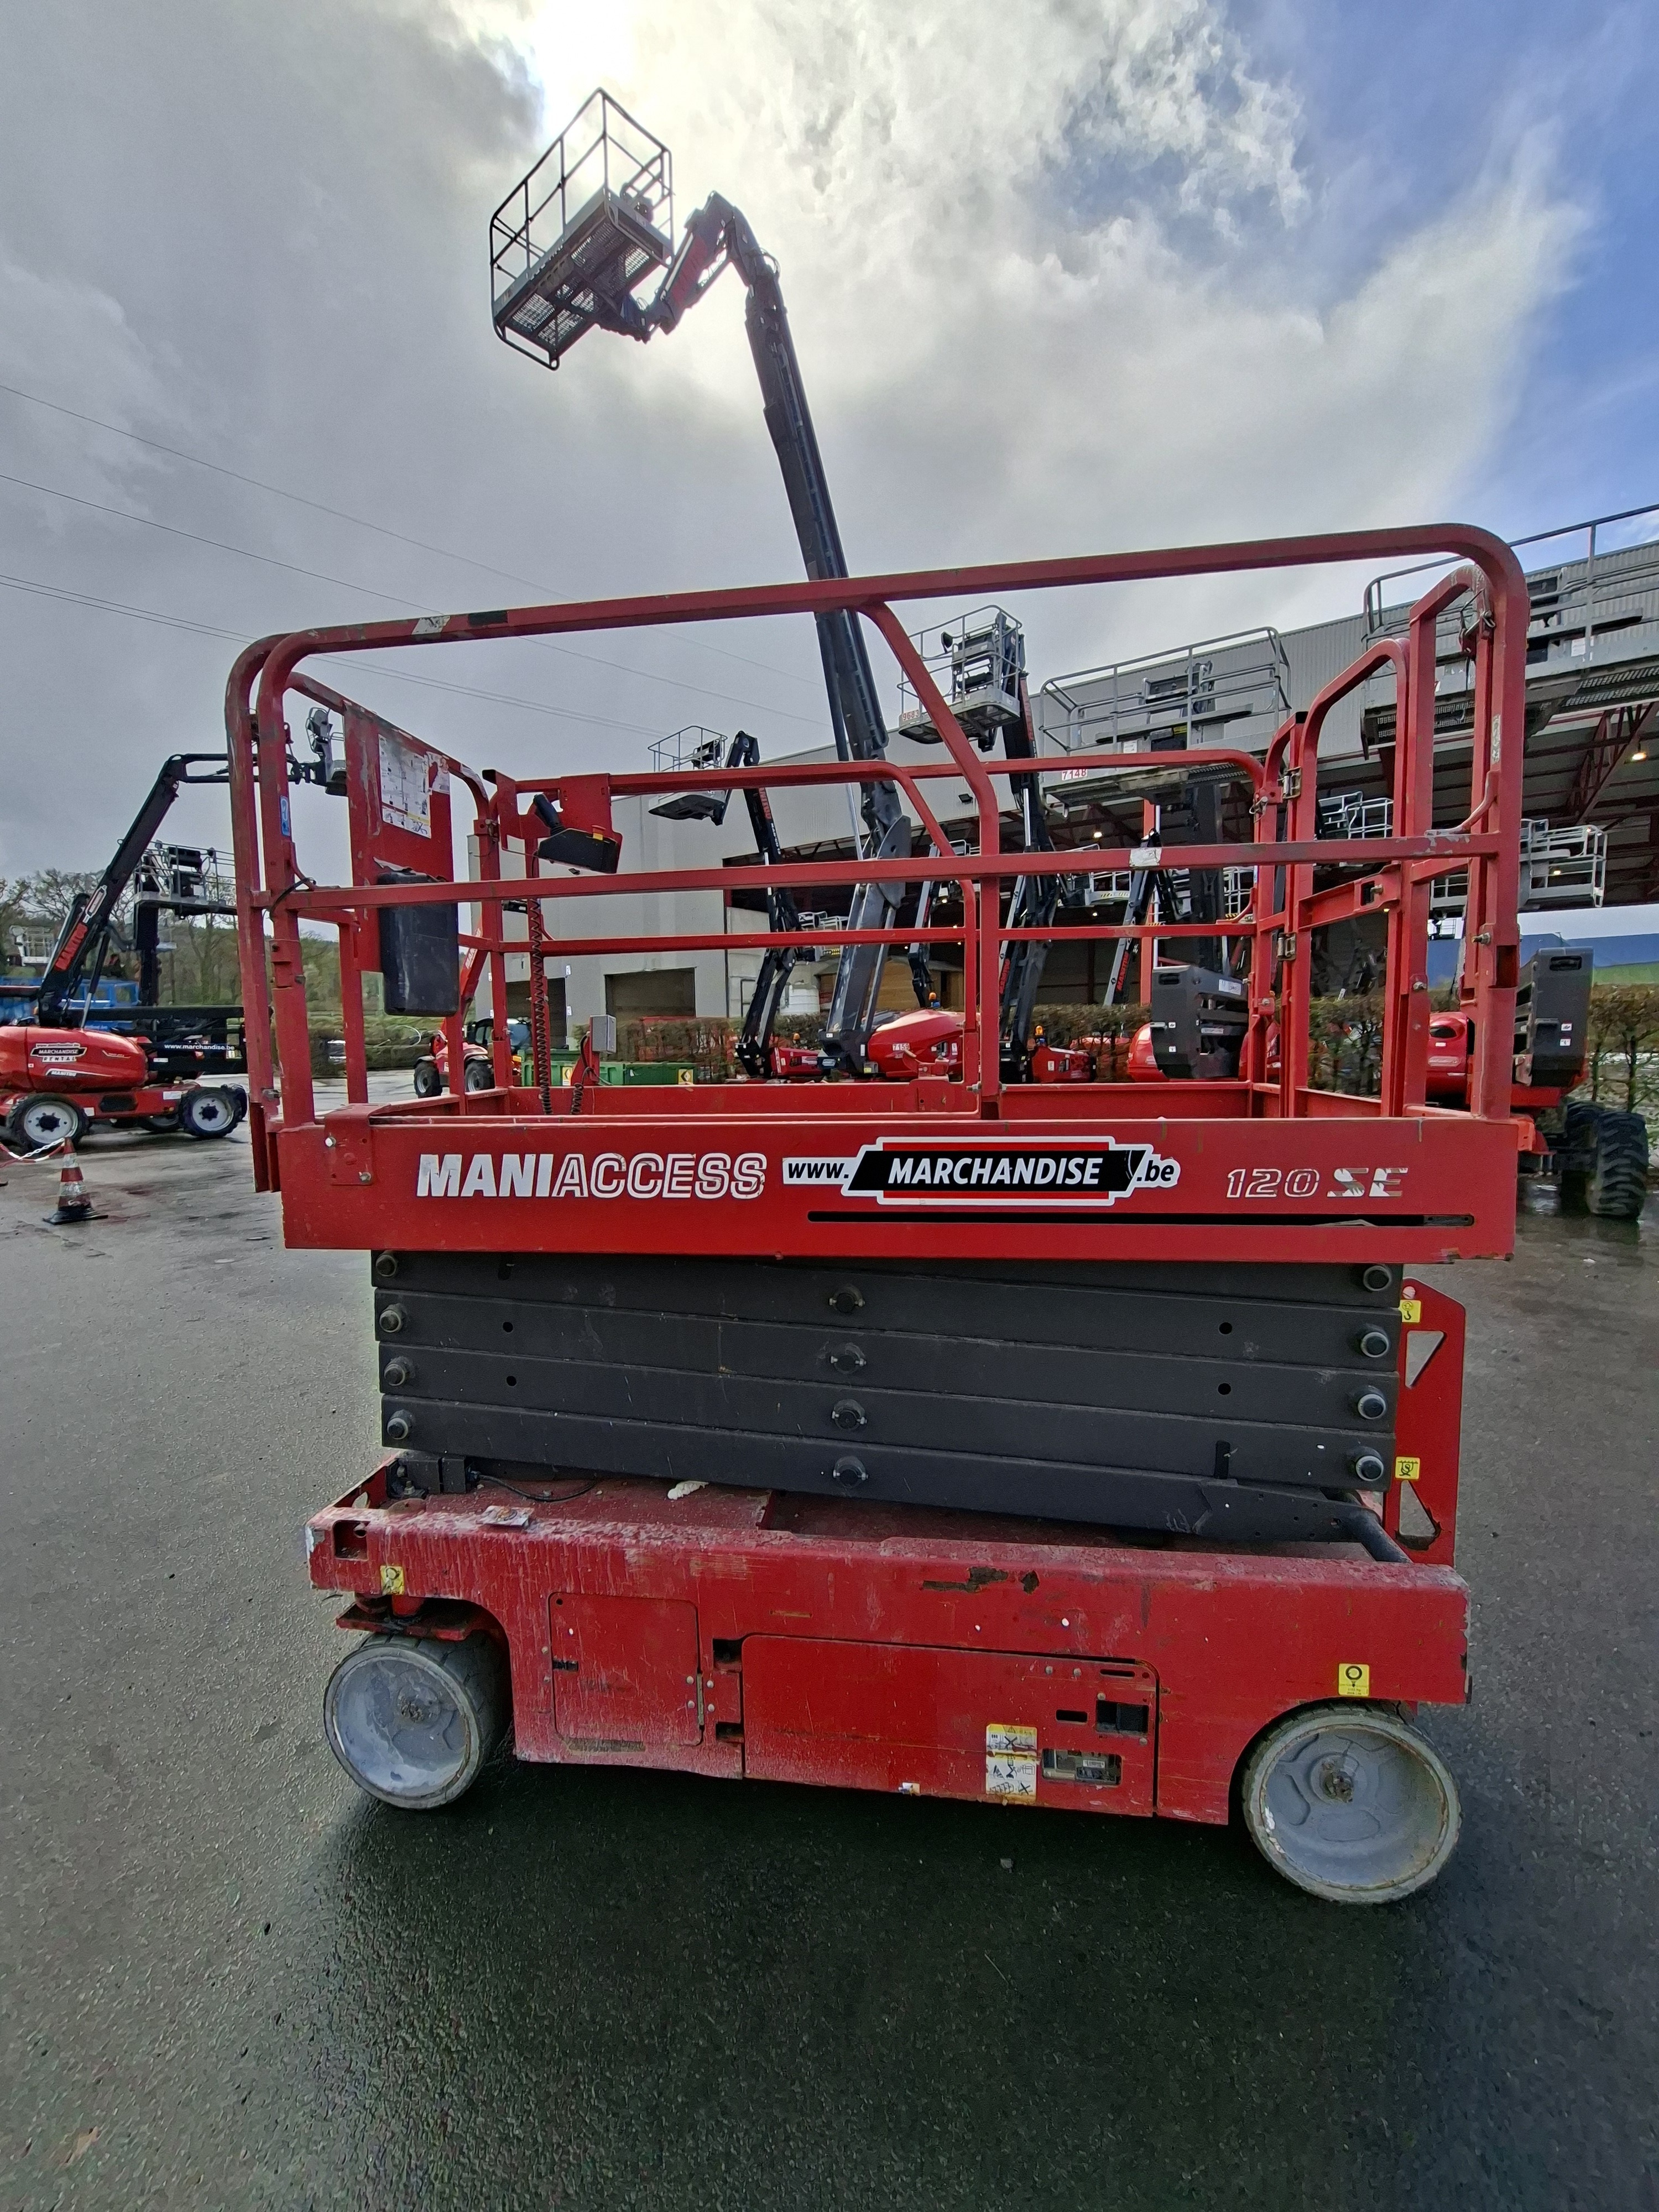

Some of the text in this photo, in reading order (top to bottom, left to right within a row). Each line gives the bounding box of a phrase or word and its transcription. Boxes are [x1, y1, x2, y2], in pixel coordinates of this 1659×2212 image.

[902, 709, 919, 721] 9683
[1062, 769, 1087, 780] 7148
[416, 1152, 767, 1199] MANIACCESS
[888, 1158, 1103, 1185] MARCHANDISE
[1226, 1167, 1408, 1198] 120 SE
